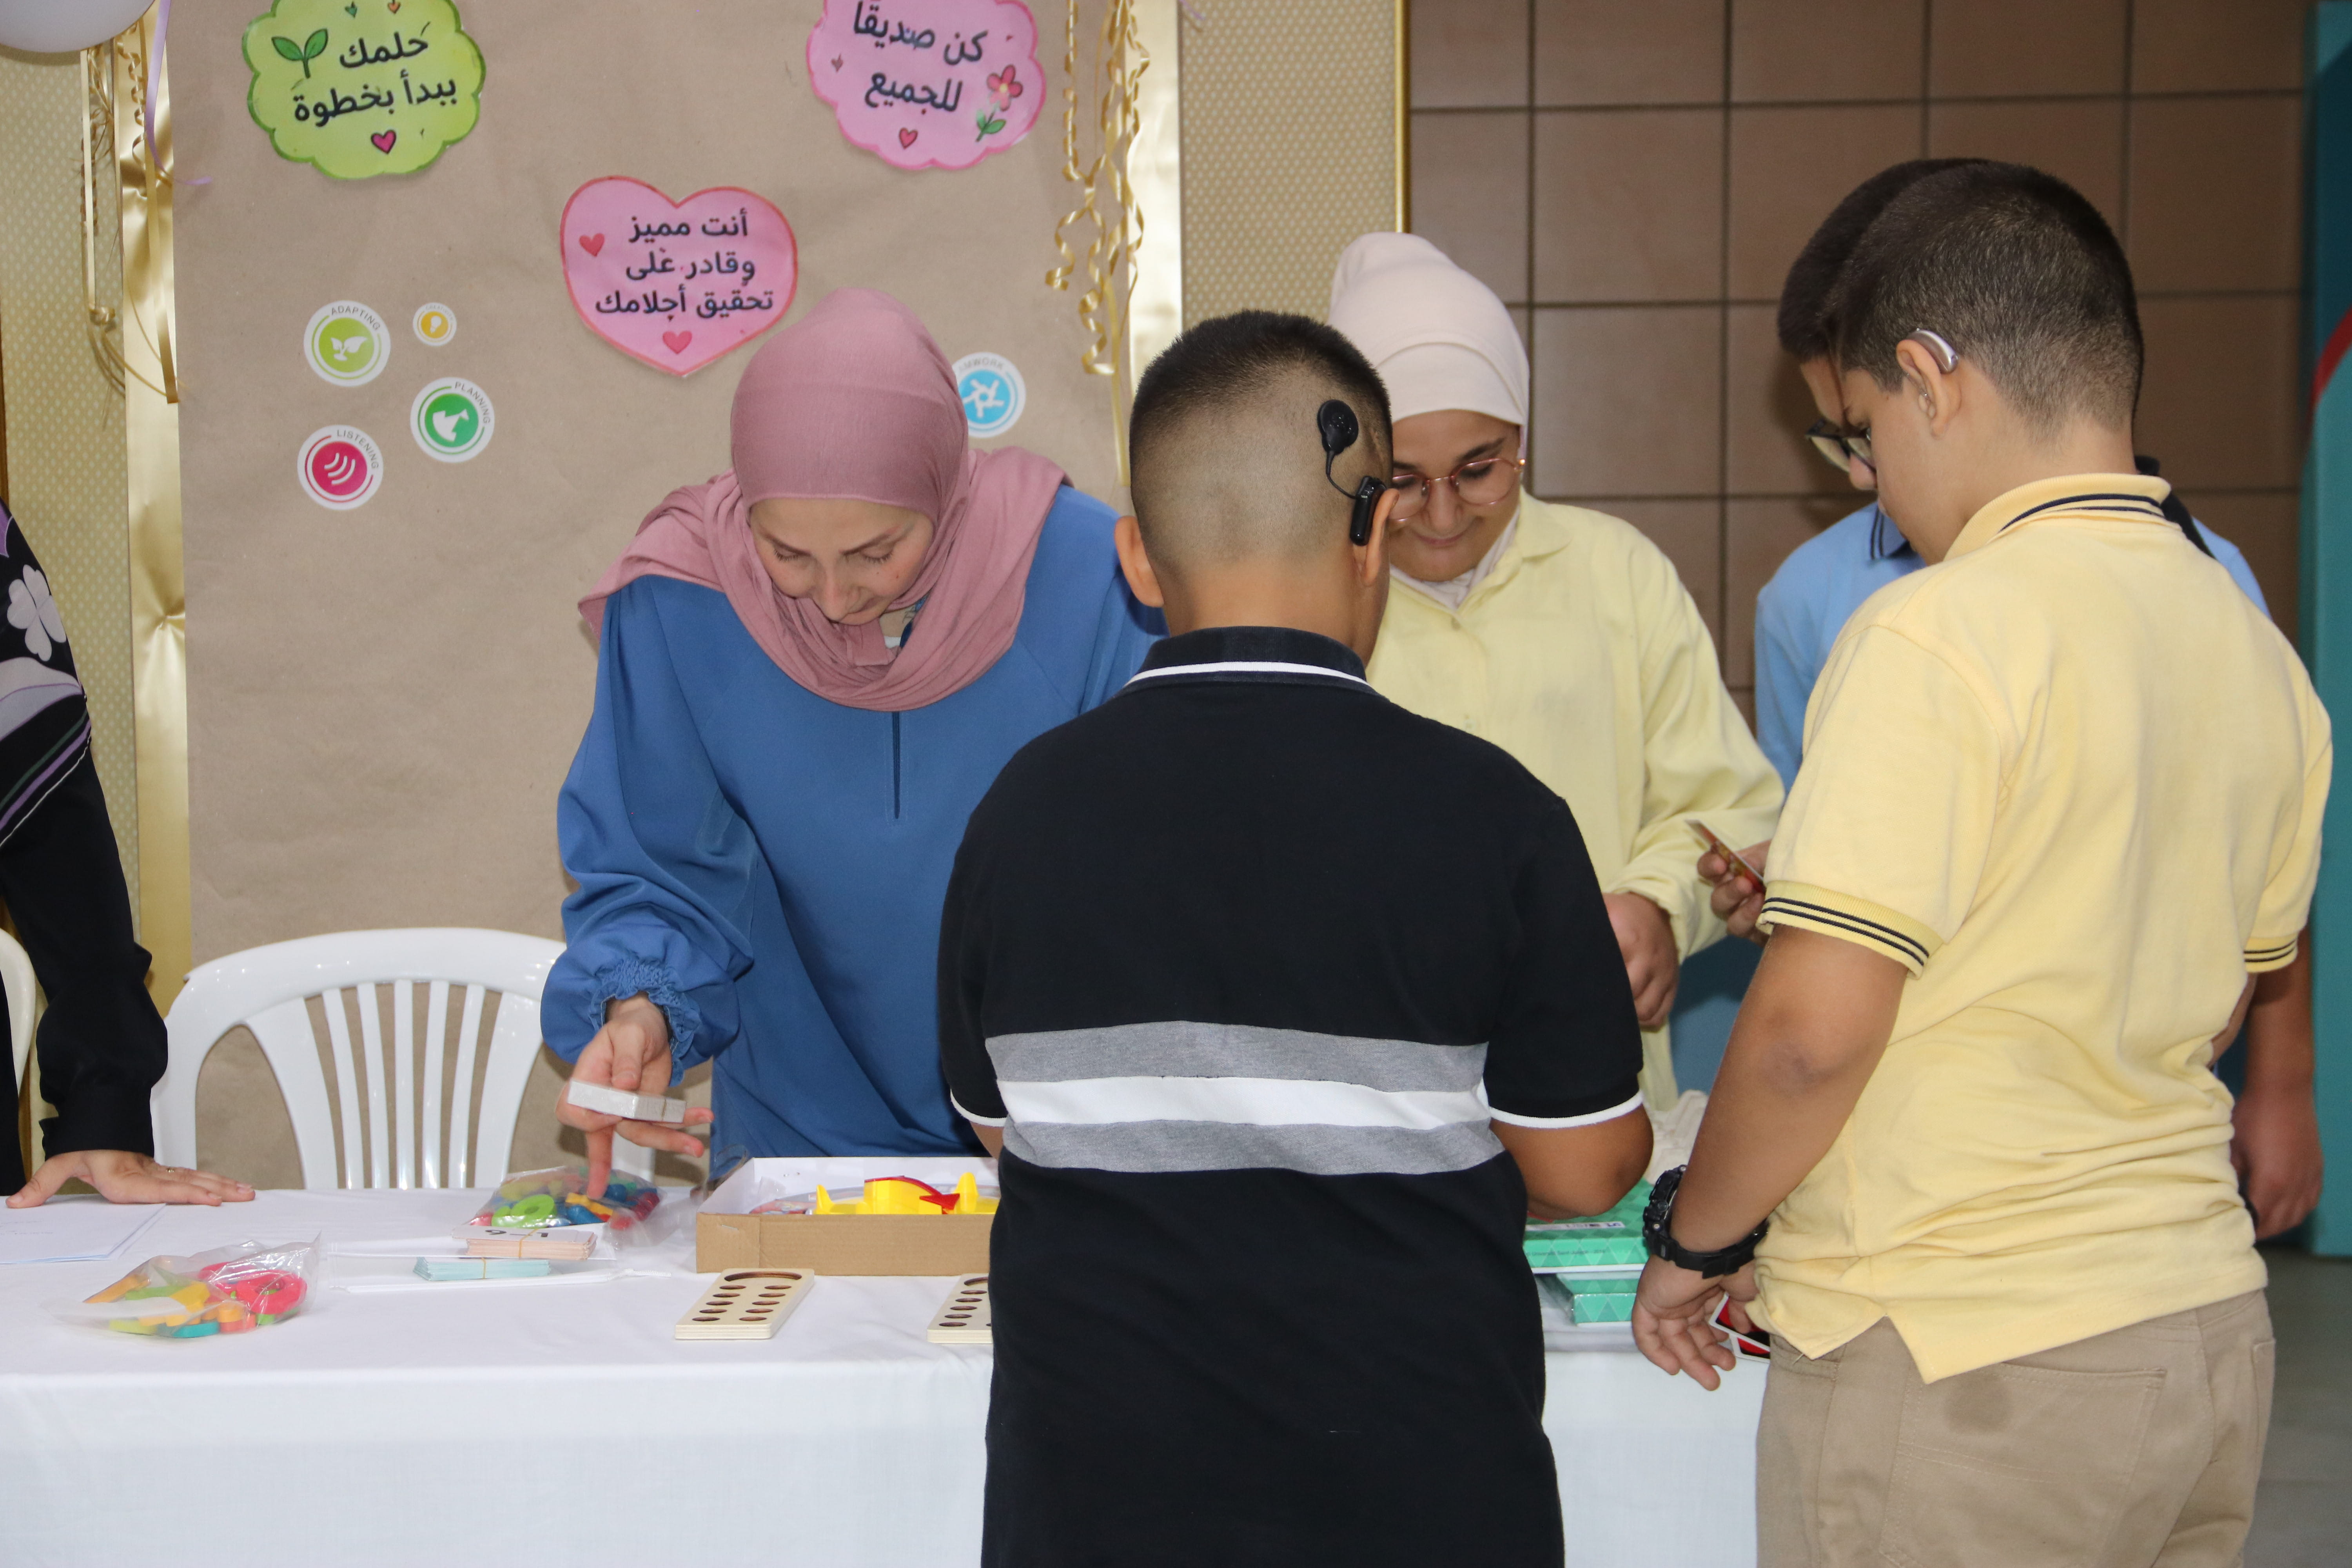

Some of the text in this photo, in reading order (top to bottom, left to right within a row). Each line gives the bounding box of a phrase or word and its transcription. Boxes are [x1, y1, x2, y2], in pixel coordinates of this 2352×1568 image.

[339, 31, 428, 68] حلمك
[944, 31, 988, 65] كن
[293, 69, 457, 127] يبدأ بخطوة
[864, 73, 963, 115] للجميع
[628, 208, 748, 243] أنت مميز
[685, 251, 755, 281] وقادر
[331, 305, 381, 331] ADAPTING
[696, 290, 774, 319] تحقيق
[455, 381, 491, 424] PLANNING
[336, 429, 379, 470] LISTENING
